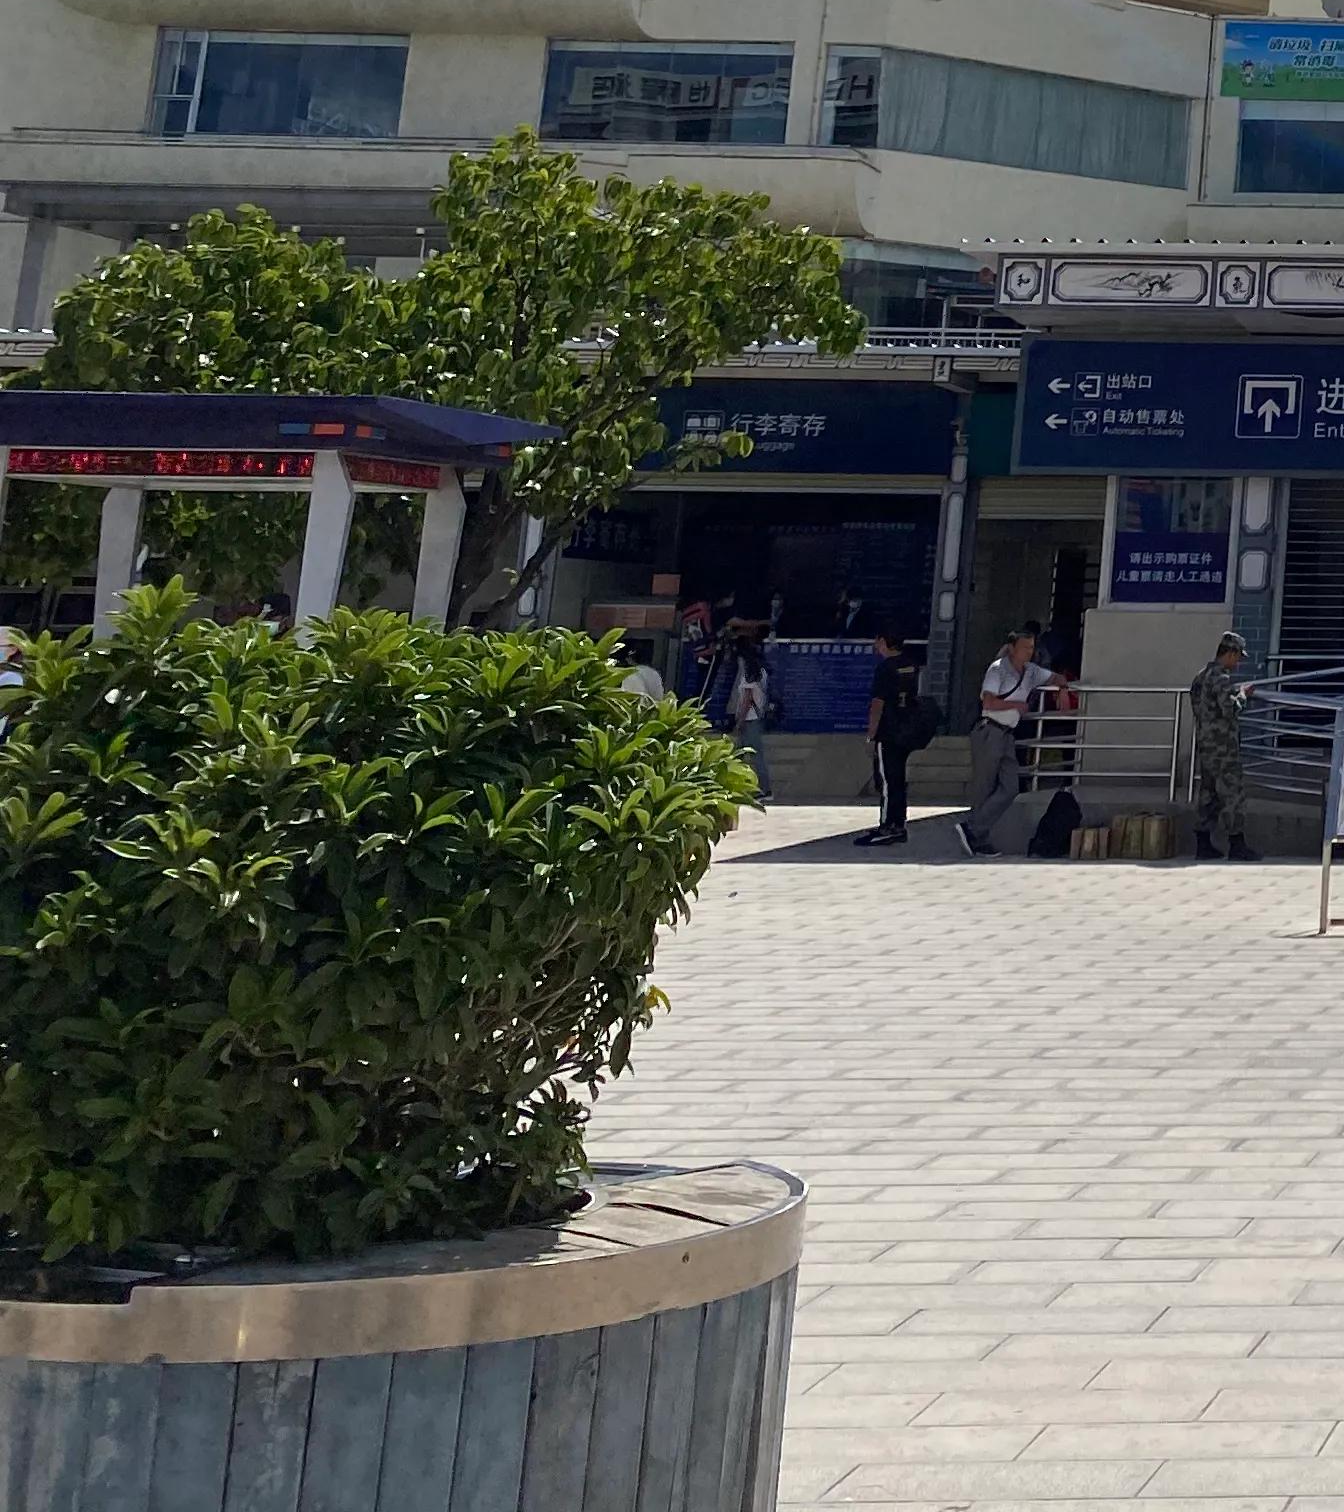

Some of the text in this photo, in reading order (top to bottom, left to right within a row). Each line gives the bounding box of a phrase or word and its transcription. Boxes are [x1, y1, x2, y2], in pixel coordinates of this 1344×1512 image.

[1106, 374, 1153, 390] 出站口
[1105, 391, 1122, 402] Exit
[1102, 407, 1185, 426] 自动售票处
[730, 413, 827, 437] 行李寄存
[1129, 552, 1213, 565] 请出示购票证件
[1116, 570, 1223, 584] 儿童票请走人工通道
